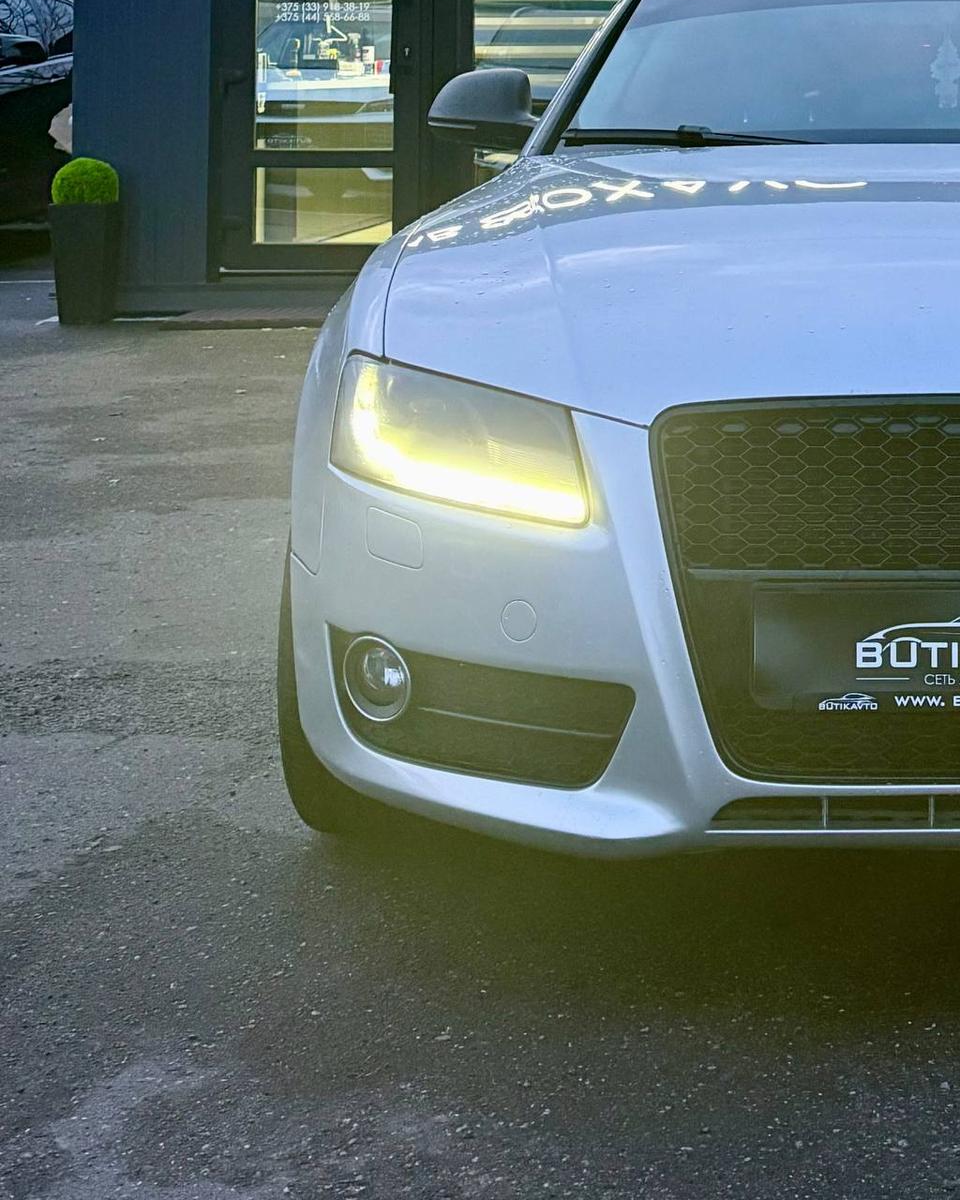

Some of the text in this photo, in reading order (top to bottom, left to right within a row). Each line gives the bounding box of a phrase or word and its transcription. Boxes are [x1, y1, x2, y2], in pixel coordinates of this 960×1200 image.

[276, 2, 299, 12] +375
[301, 2, 321, 13] (33)
[301, 12, 321, 23] (44)
[923, 673, 956, 686] СЕТЬ
[818, 701, 878, 711] BUTIKAVTO
[894, 695, 946, 707] WWW.
